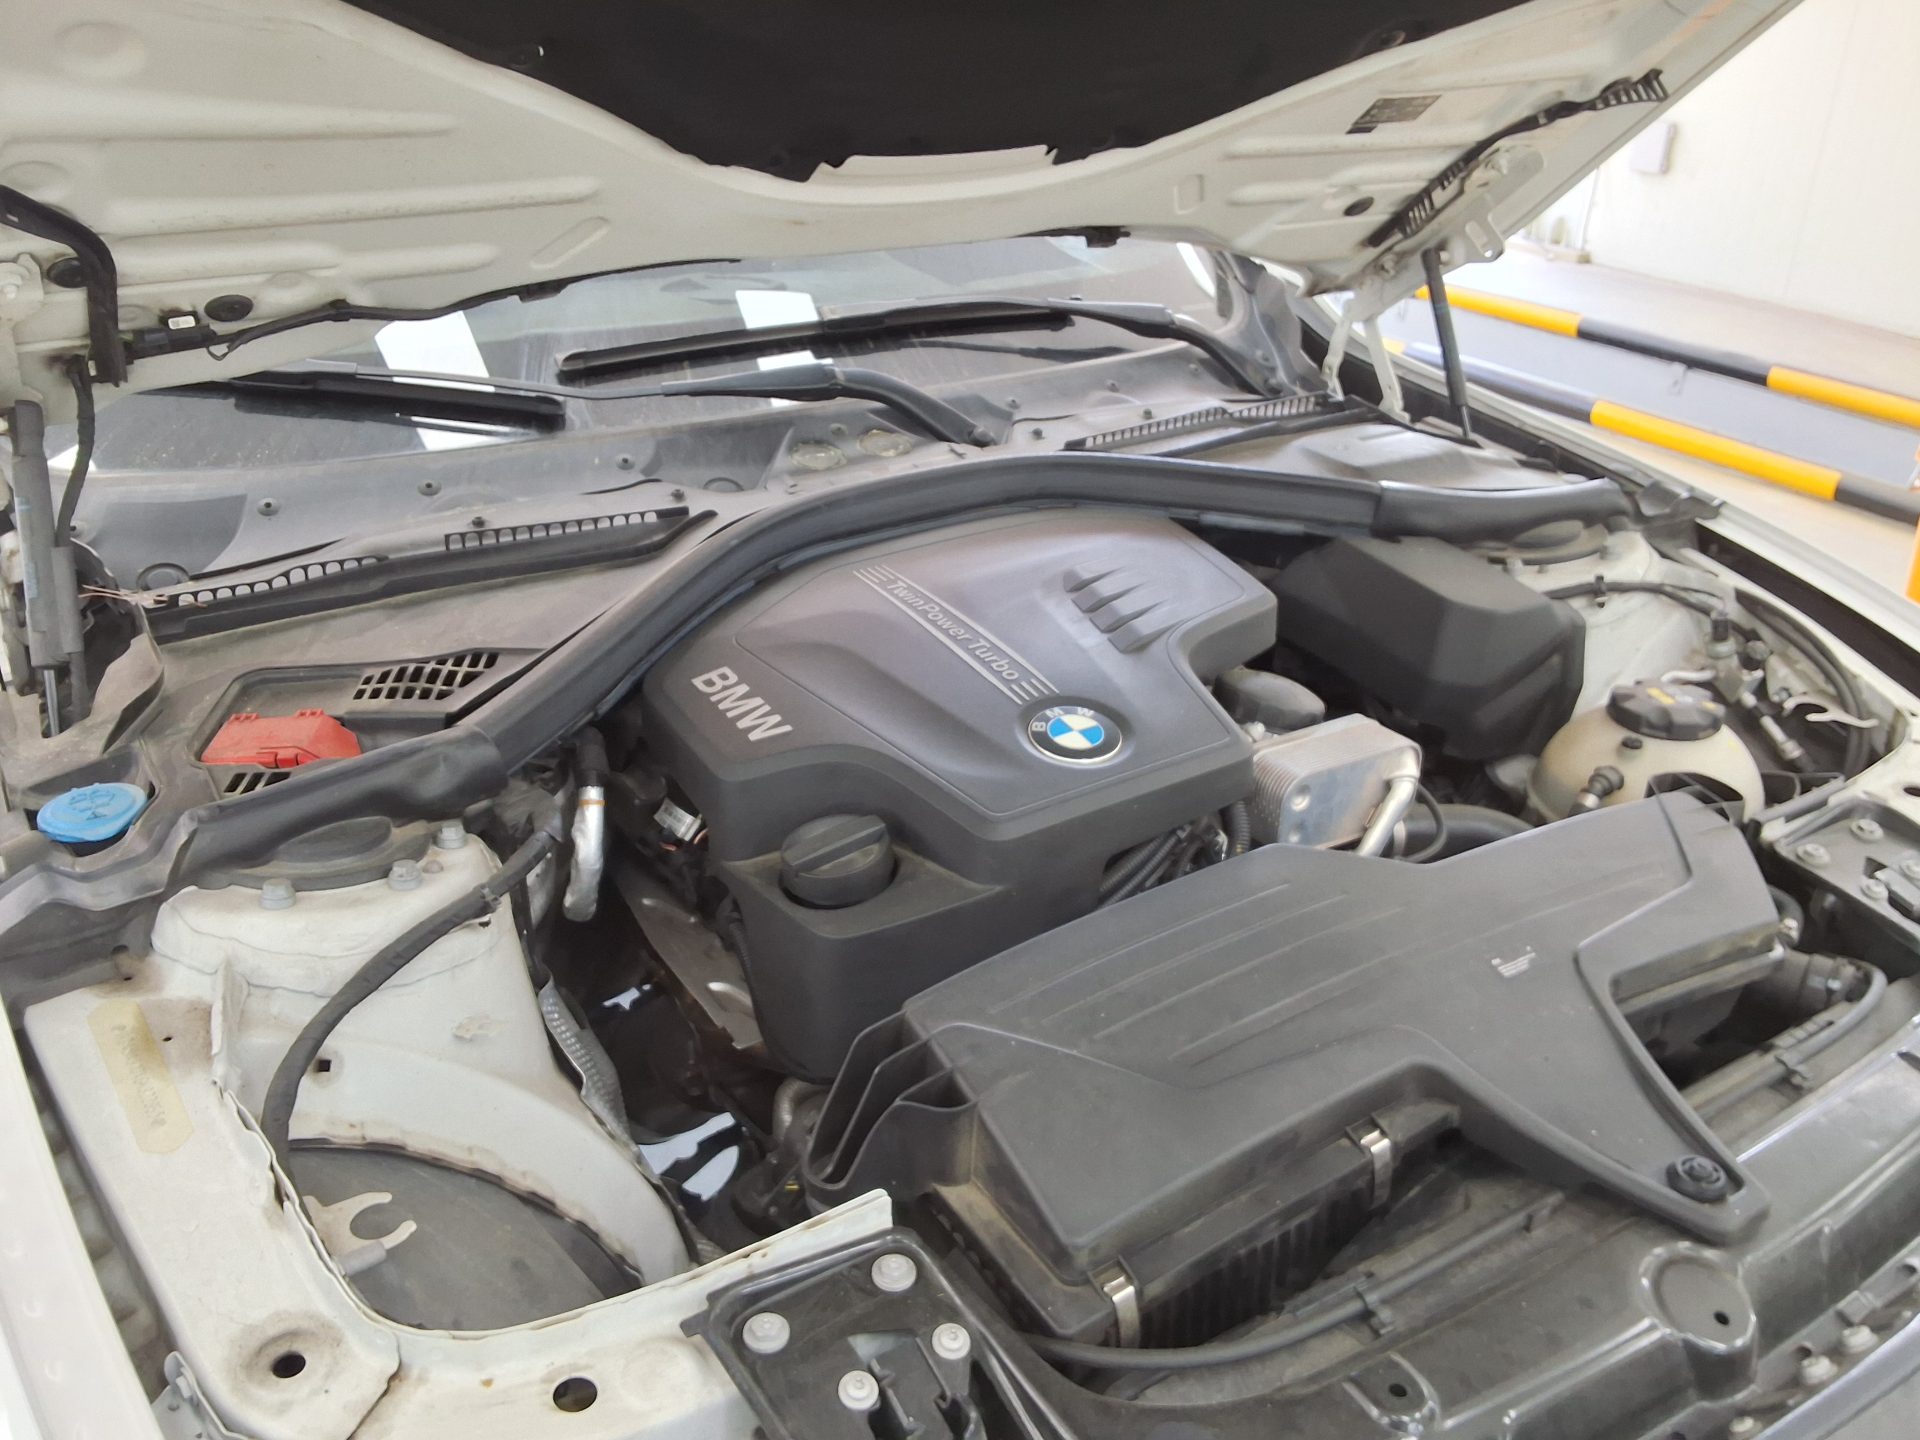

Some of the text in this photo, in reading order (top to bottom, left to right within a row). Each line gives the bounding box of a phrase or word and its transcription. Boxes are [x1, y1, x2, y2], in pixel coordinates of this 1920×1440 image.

[887, 579, 1019, 680] TwinPower Turbo
[691, 666, 793, 742] BMW
[1031, 706, 1095, 732] BMW
